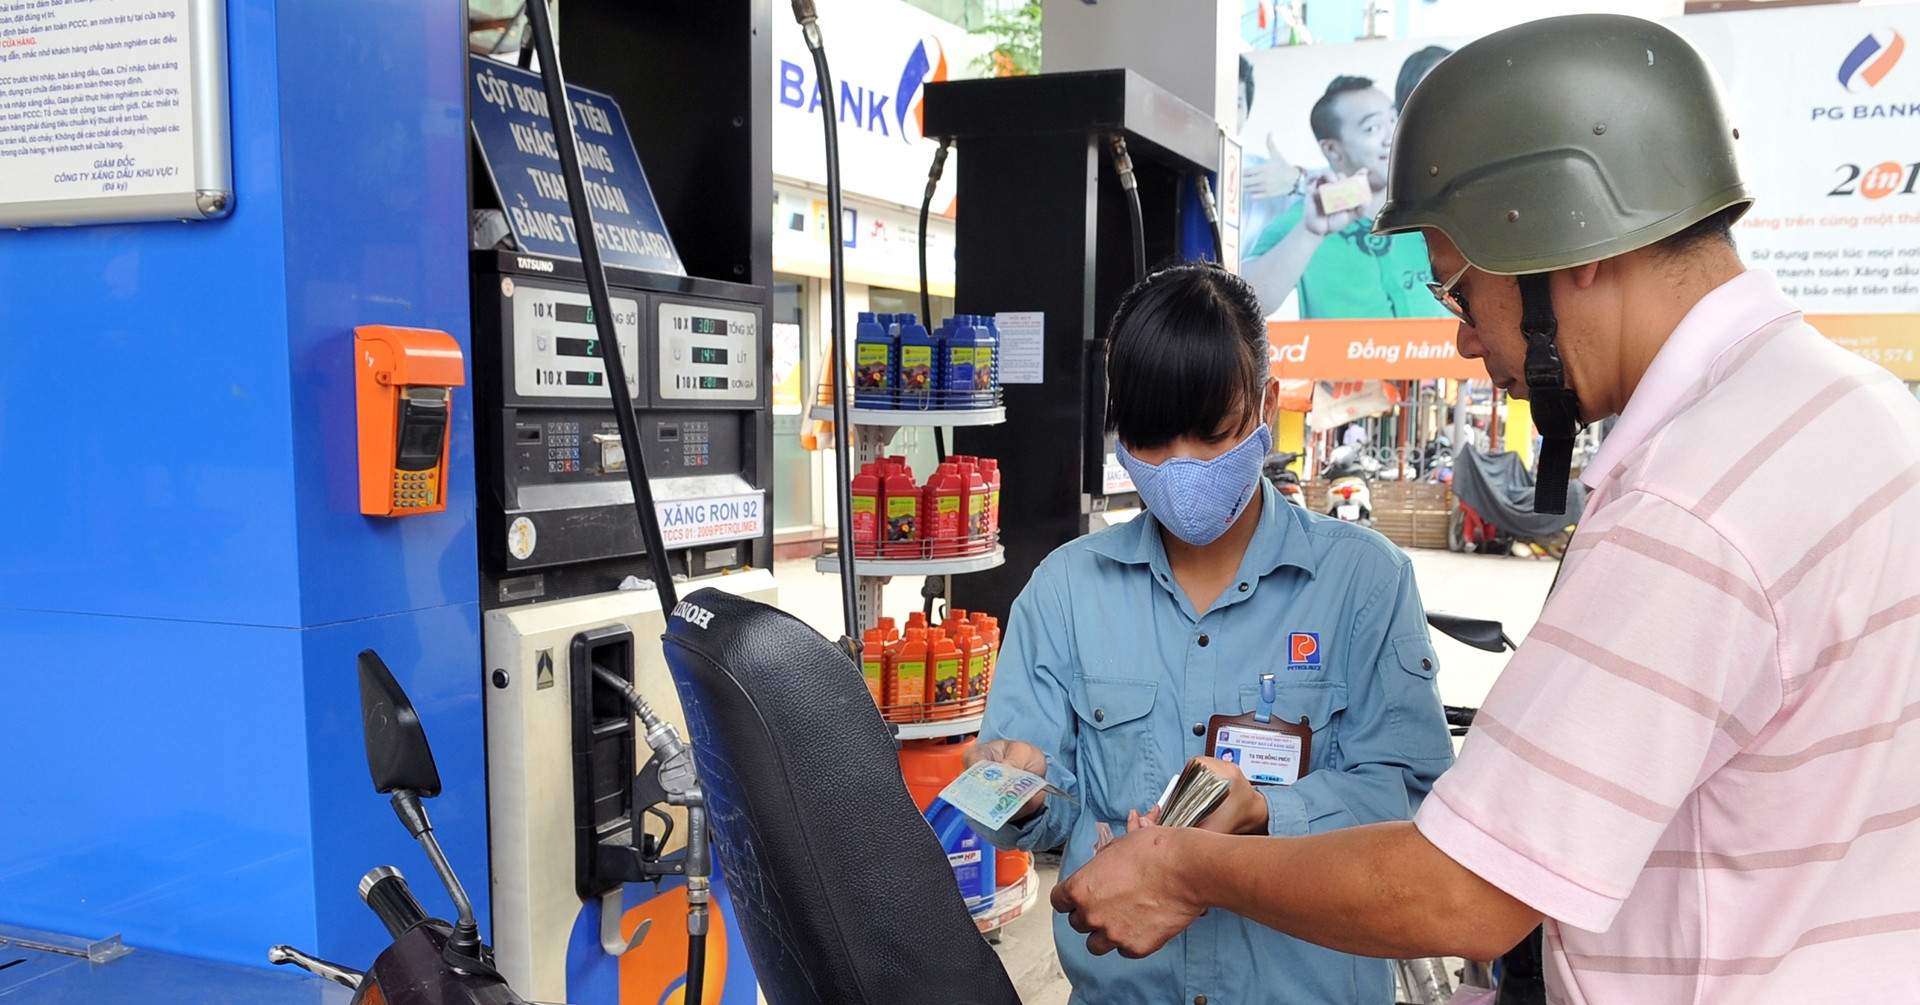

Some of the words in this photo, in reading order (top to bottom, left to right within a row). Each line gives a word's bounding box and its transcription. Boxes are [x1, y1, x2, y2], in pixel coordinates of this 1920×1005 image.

[476, 68, 514, 113] CỘT
[512, 83, 550, 118] BƠM
[1811, 106, 1844, 121] PG
[1853, 103, 1920, 119] BANK
[509, 121, 560, 161] KHÁC
[575, 132, 615, 174] ÀNG
[80, 173, 90, 181] TY
[136, 169, 156, 177] KHU
[526, 167, 568, 203] THA
[583, 177, 630, 215] TOÁN
[594, 222, 672, 260] FLEXICARD
[517, 257, 554, 272] TATSUNO
[533, 302, 544, 318] 10
[547, 303, 553, 318] X
[586, 307, 594, 323] 0
[673, 316, 682, 330] 10
[683, 317, 689, 330] X
[698, 319, 715, 333] 300
[586, 340, 594, 356] 2
[1347, 337, 1401, 363] Đồng
[1405, 340, 1456, 359] hành
[543, 370, 554, 385] 10
[556, 371, 563, 385] X
[682, 376, 691, 389] 10
[692, 376, 698, 389] X
[664, 503, 705, 527] XĂNG
[710, 502, 739, 522] RON
[743, 500, 757, 518] 92
[663, 528, 683, 541] TCCS
